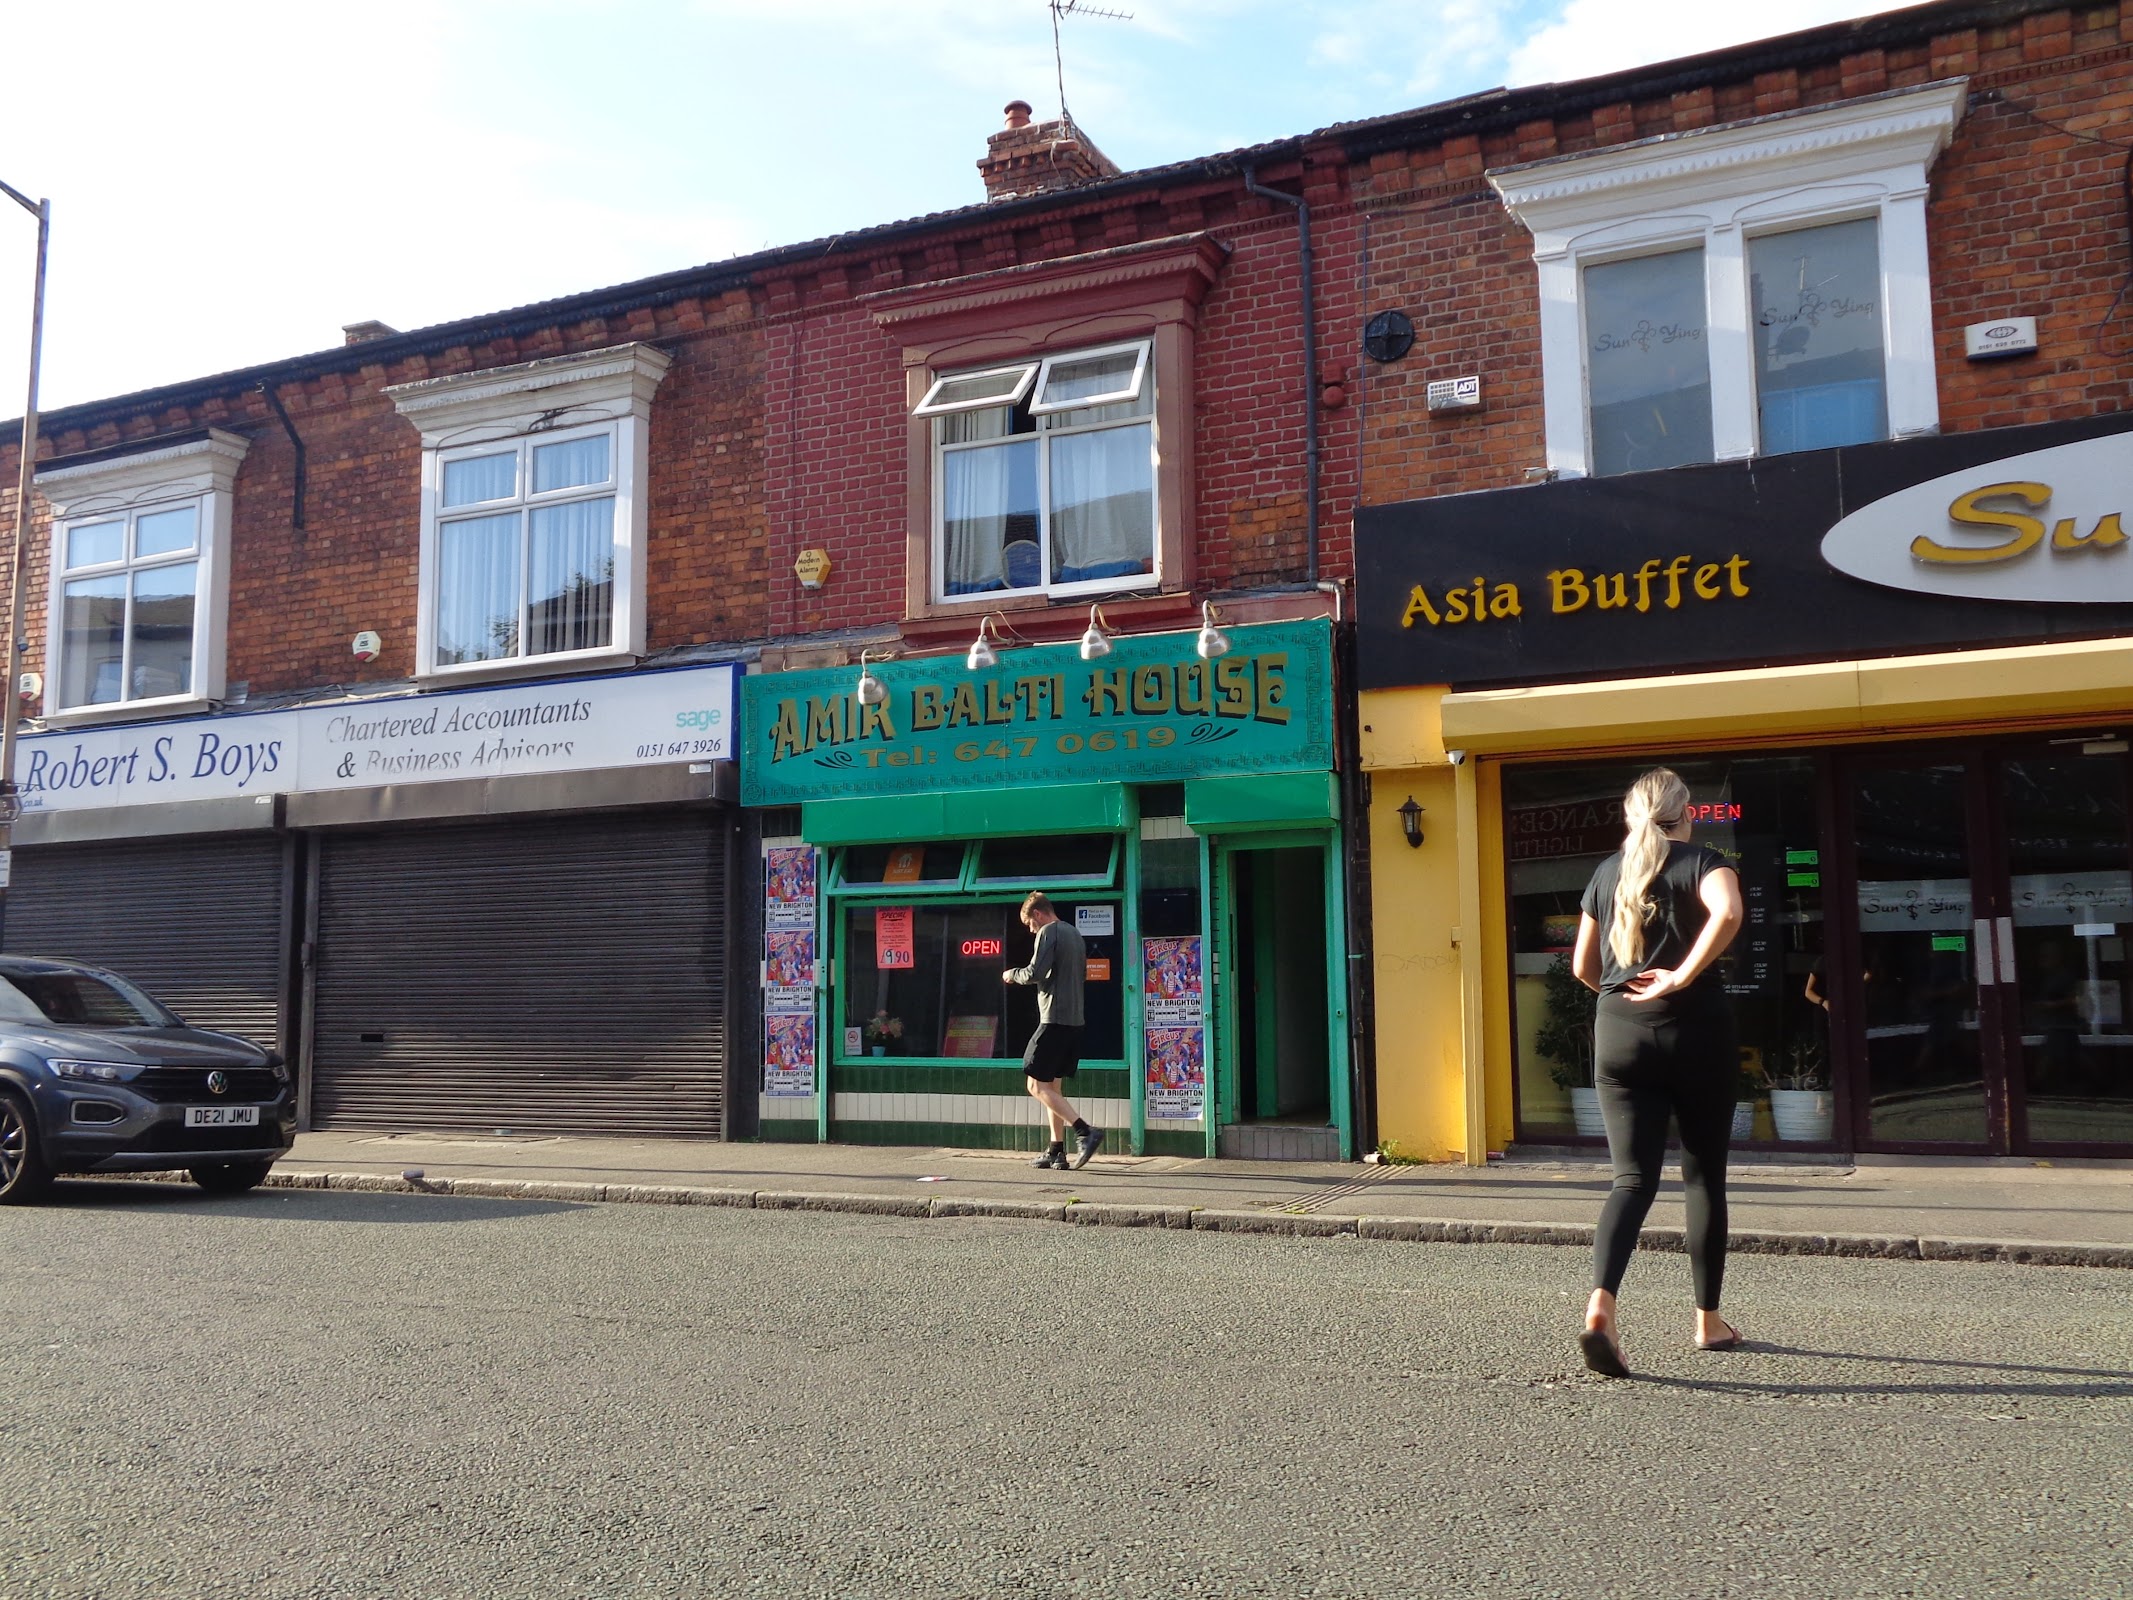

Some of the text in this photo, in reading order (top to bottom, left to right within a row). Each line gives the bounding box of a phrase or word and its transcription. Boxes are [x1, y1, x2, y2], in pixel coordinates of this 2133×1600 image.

[1594, 323, 1700, 351] Sun Ying
[1458, 381, 1475, 393] ADT
[798, 557, 820, 565] Modern
[1401, 553, 1750, 628] Asia Buffet
[769, 651, 1291, 764] AMIR BALTI HOUSE
[327, 698, 591, 743] Chartered Accountants
[676, 709, 721, 731] sage
[637, 739, 722, 758] 0151 647 3926
[860, 726, 1176, 768] Tel: 647 0619
[26, 733, 281, 792] Robert S. Boys
[336, 751, 355, 778] &
[366, 748, 462, 775] Business
[1864, 897, 1966, 914] Sun Ying
[962, 940, 1000, 955] OPEN
[1147, 941, 1178, 960] CIRCUS
[1149, 1032, 1180, 1050] CIRCUS
[194, 1108, 252, 1123] DE21 JMU
